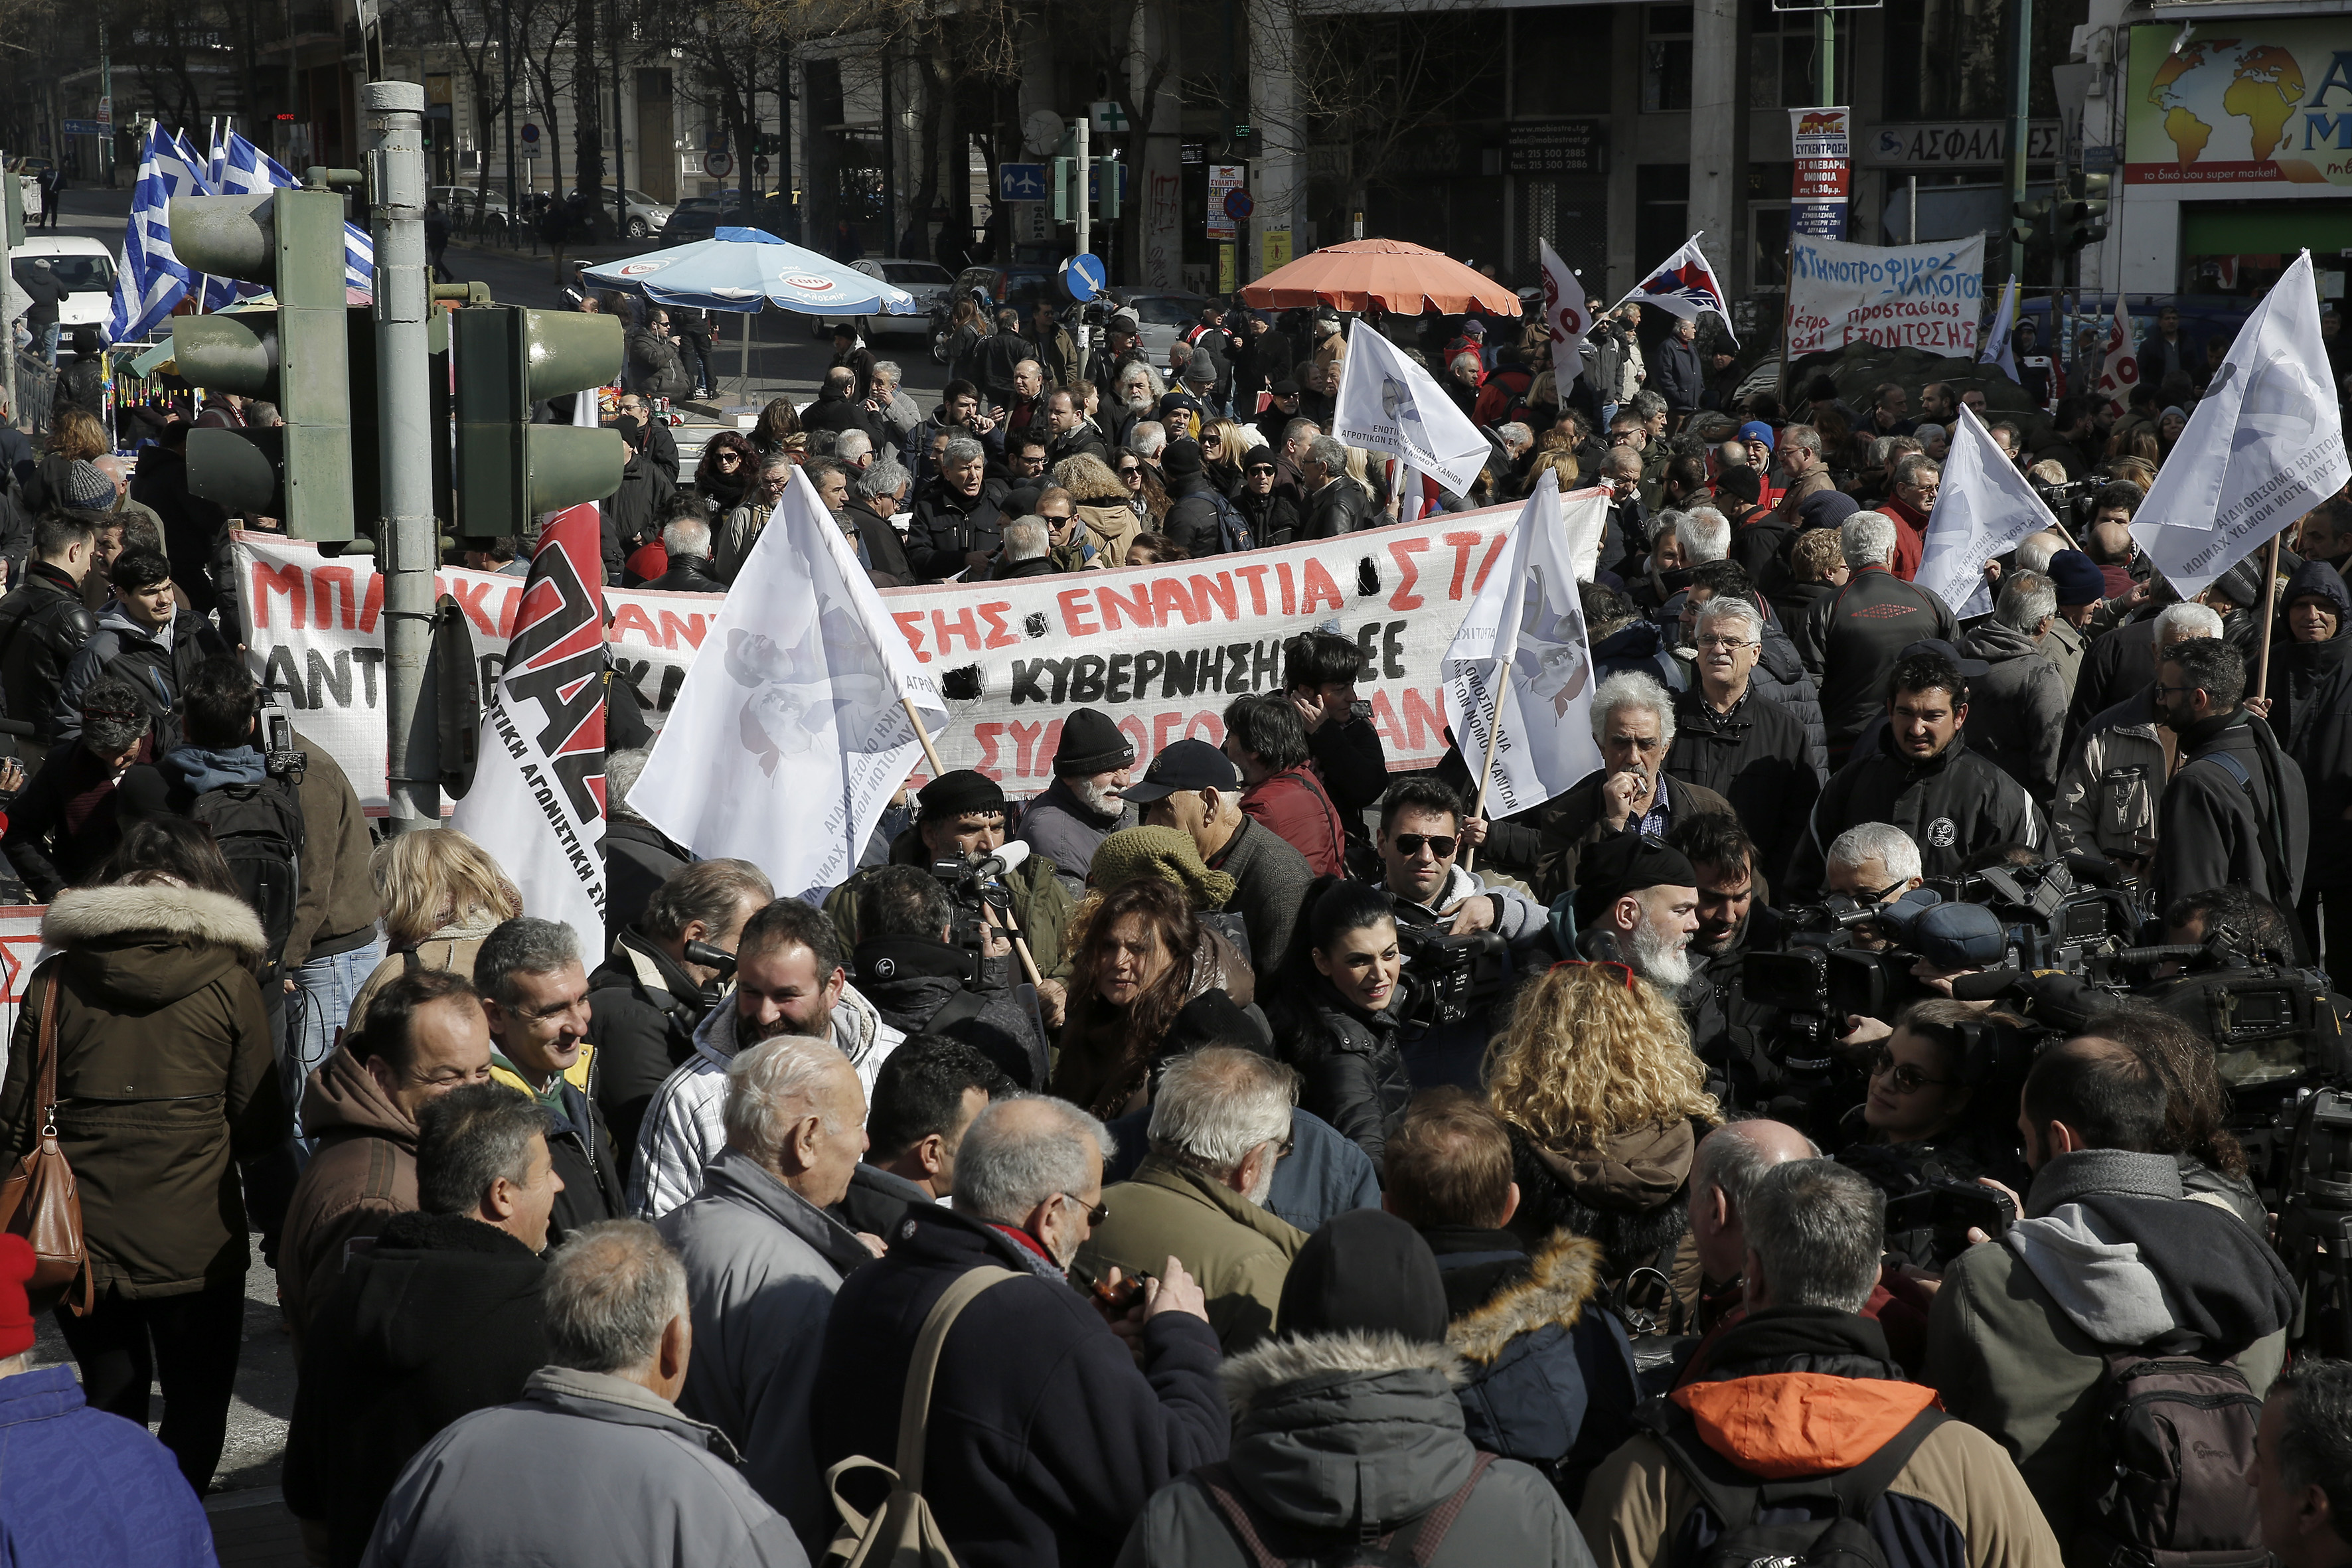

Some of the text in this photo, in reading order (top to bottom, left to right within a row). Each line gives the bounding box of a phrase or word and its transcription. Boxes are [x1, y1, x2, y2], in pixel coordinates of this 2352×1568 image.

[1510, 124, 1589, 133] www.mobiestreet.gr
[1508, 135, 1591, 145] sales@mobiestreet.gr
[1907, 128, 2058, 161] ΑΣΦΑΛΕΣ
[1528, 149, 1541, 158] 215
[1565, 149, 1586, 157] 2885
[1796, 143, 1847, 155] ΣΥΓΚΕΝΤΡΩΣΗ
[1529, 161, 1542, 169] 215
[1566, 160, 1588, 169] 2886
[1798, 160, 1845, 170] 21 ΦΛΕΒΑΡΗ
[1804, 172, 1837, 182] ΟΜΟΝΟΙΑ
[2158, 169, 2180, 180] δικό
[2183, 171, 2203, 179] σου
[2207, 171, 2236, 181] super
[2238, 168, 2276, 178] market!
[1342, 430, 1385, 444] ΑΓΡΟΤΙΚΩΝ
[1408, 451, 1435, 468] ΝΟΜΟΥ
[1436, 465, 1463, 486] ΧΑΝΙΩΝ
[1056, 557, 1344, 638] ΕΝΑΝΤΙΑ
[1490, 759, 1519, 810] ΧΑΝΙΩΝ
[520, 763, 595, 882] ΑΓΩΝΙΣΤΙΚΗ
